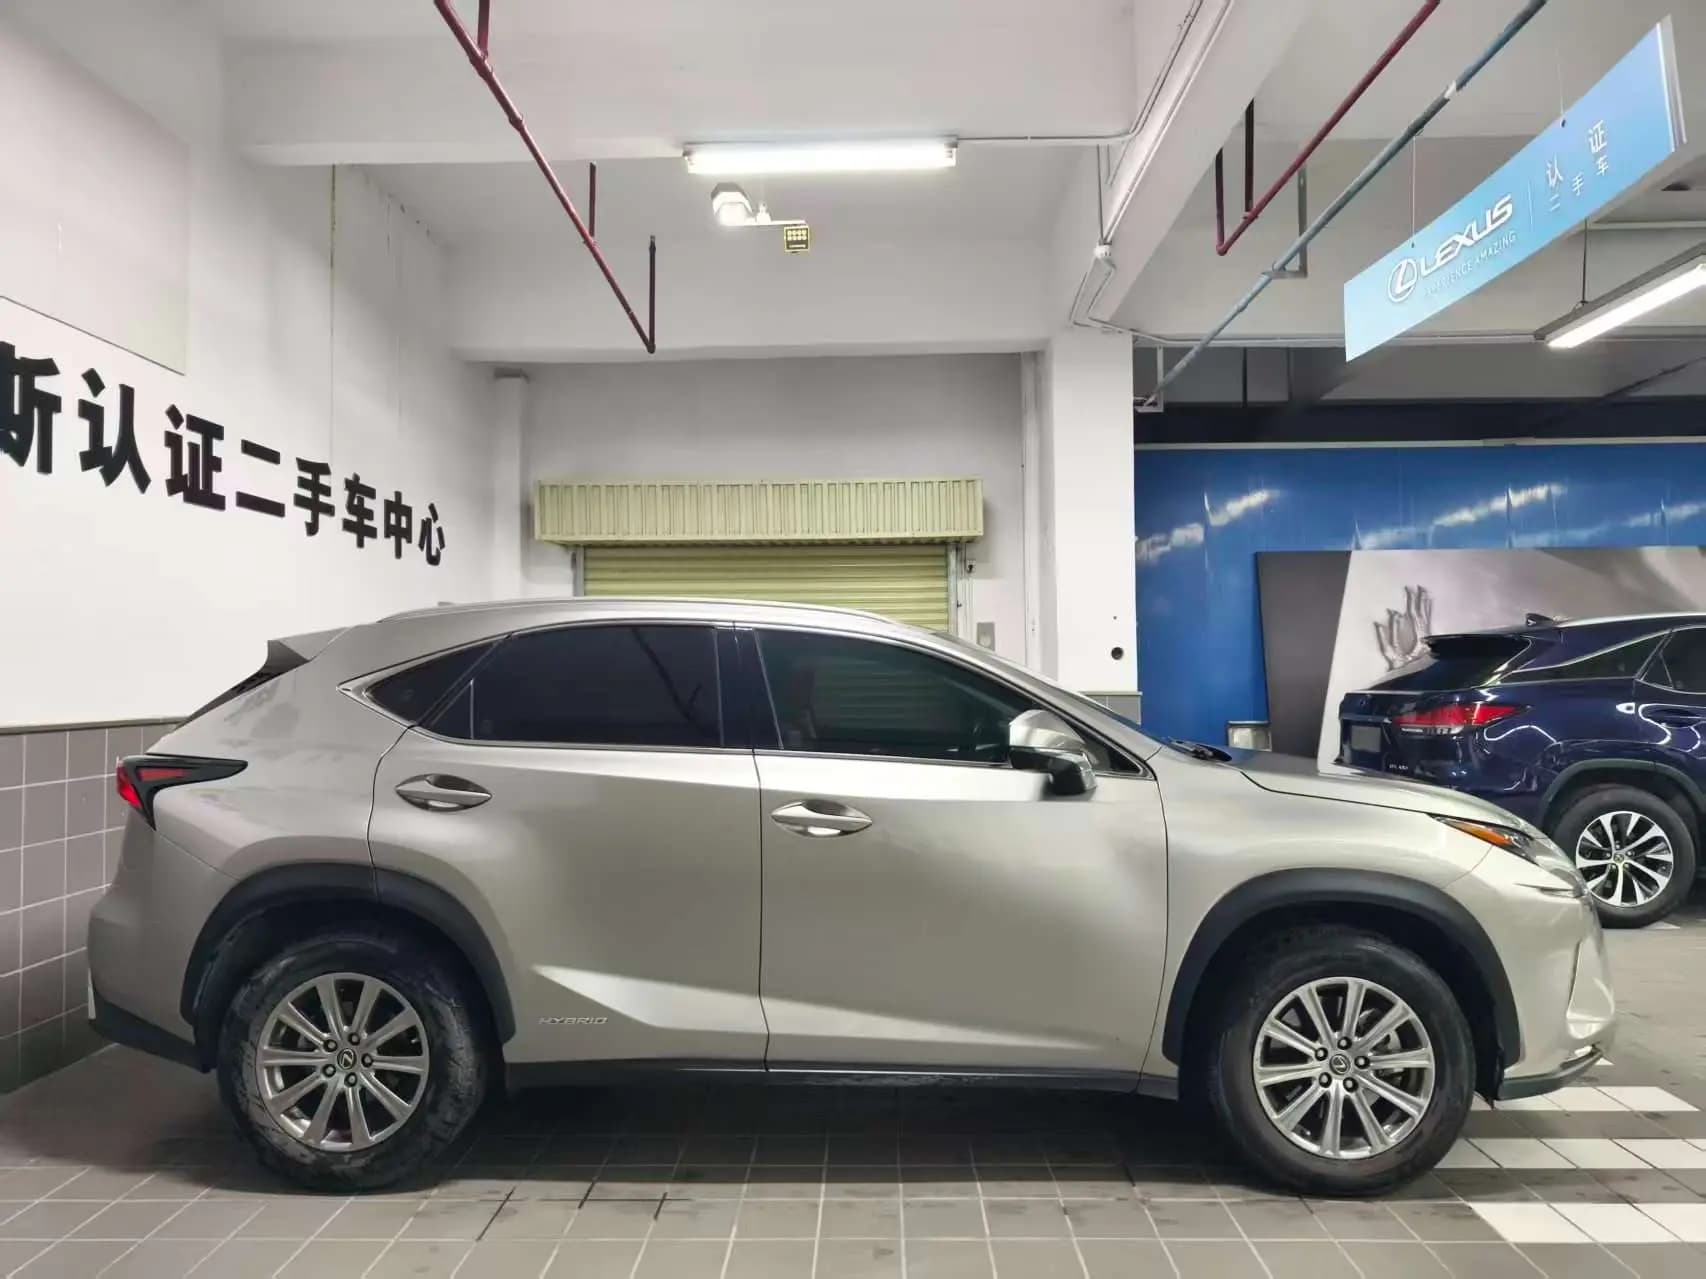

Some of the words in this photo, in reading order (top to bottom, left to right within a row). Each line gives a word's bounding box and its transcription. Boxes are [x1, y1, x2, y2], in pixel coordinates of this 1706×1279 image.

[1546, 119, 1607, 188] 认证
[1549, 155, 1608, 212] 二手车
[1421, 194, 1513, 277] LEXUS
[539, 1017, 608, 1025] HYBRID
